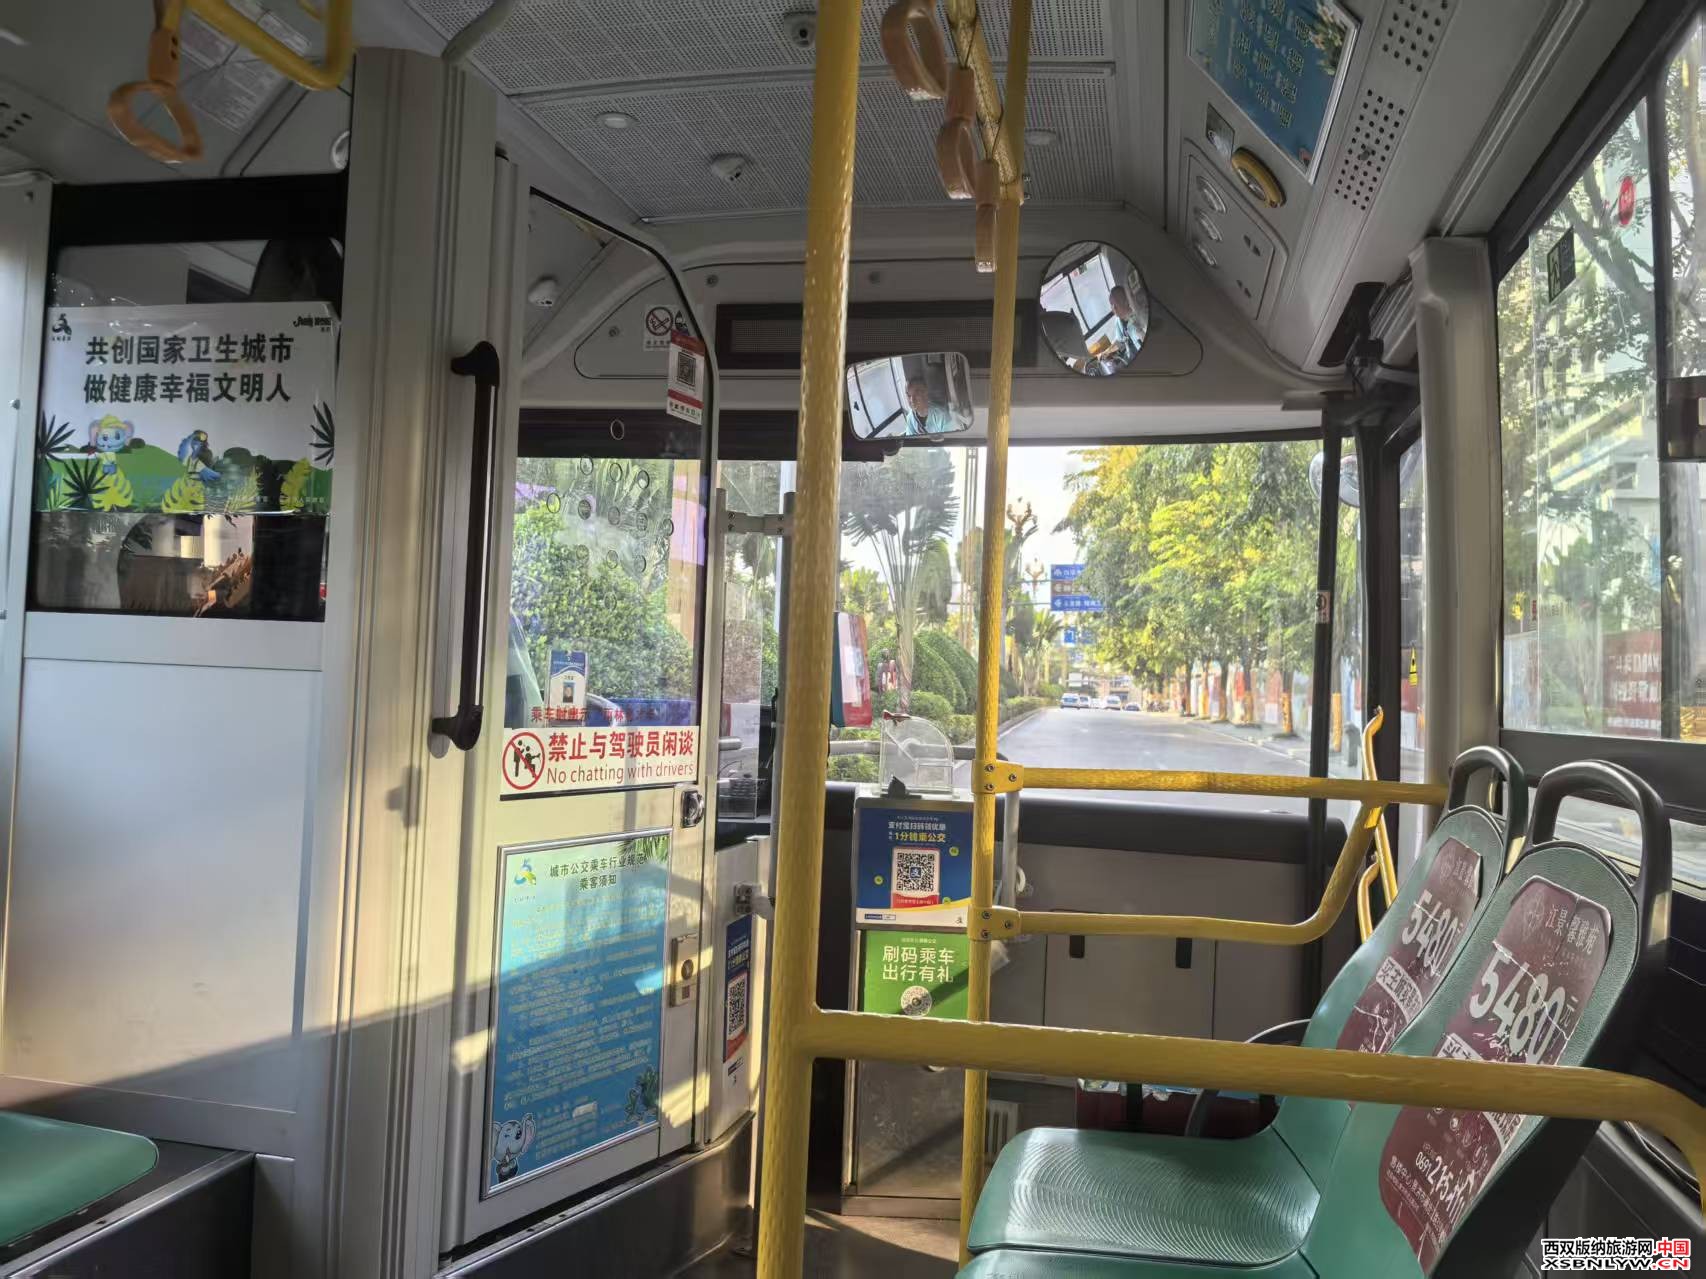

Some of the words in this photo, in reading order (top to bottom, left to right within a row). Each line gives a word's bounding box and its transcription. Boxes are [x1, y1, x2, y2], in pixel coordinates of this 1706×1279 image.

[85, 333, 295, 365] 共创国家卫生城市
[83, 373, 292, 404] 做健康幸福文明人
[548, 730, 694, 763] 禁止与驾驶员闲谈
[547, 767, 567, 785] No
[570, 763, 625, 785] chatting
[627, 762, 653, 780] with
[655, 760, 694, 778] drivers
[550, 853, 649, 878] 城市公交乘车行业规范
[578, 874, 618, 892] 乘客须知
[881, 945, 956, 966] 刷码乘车
[881, 964, 955, 984] 出行有礼
